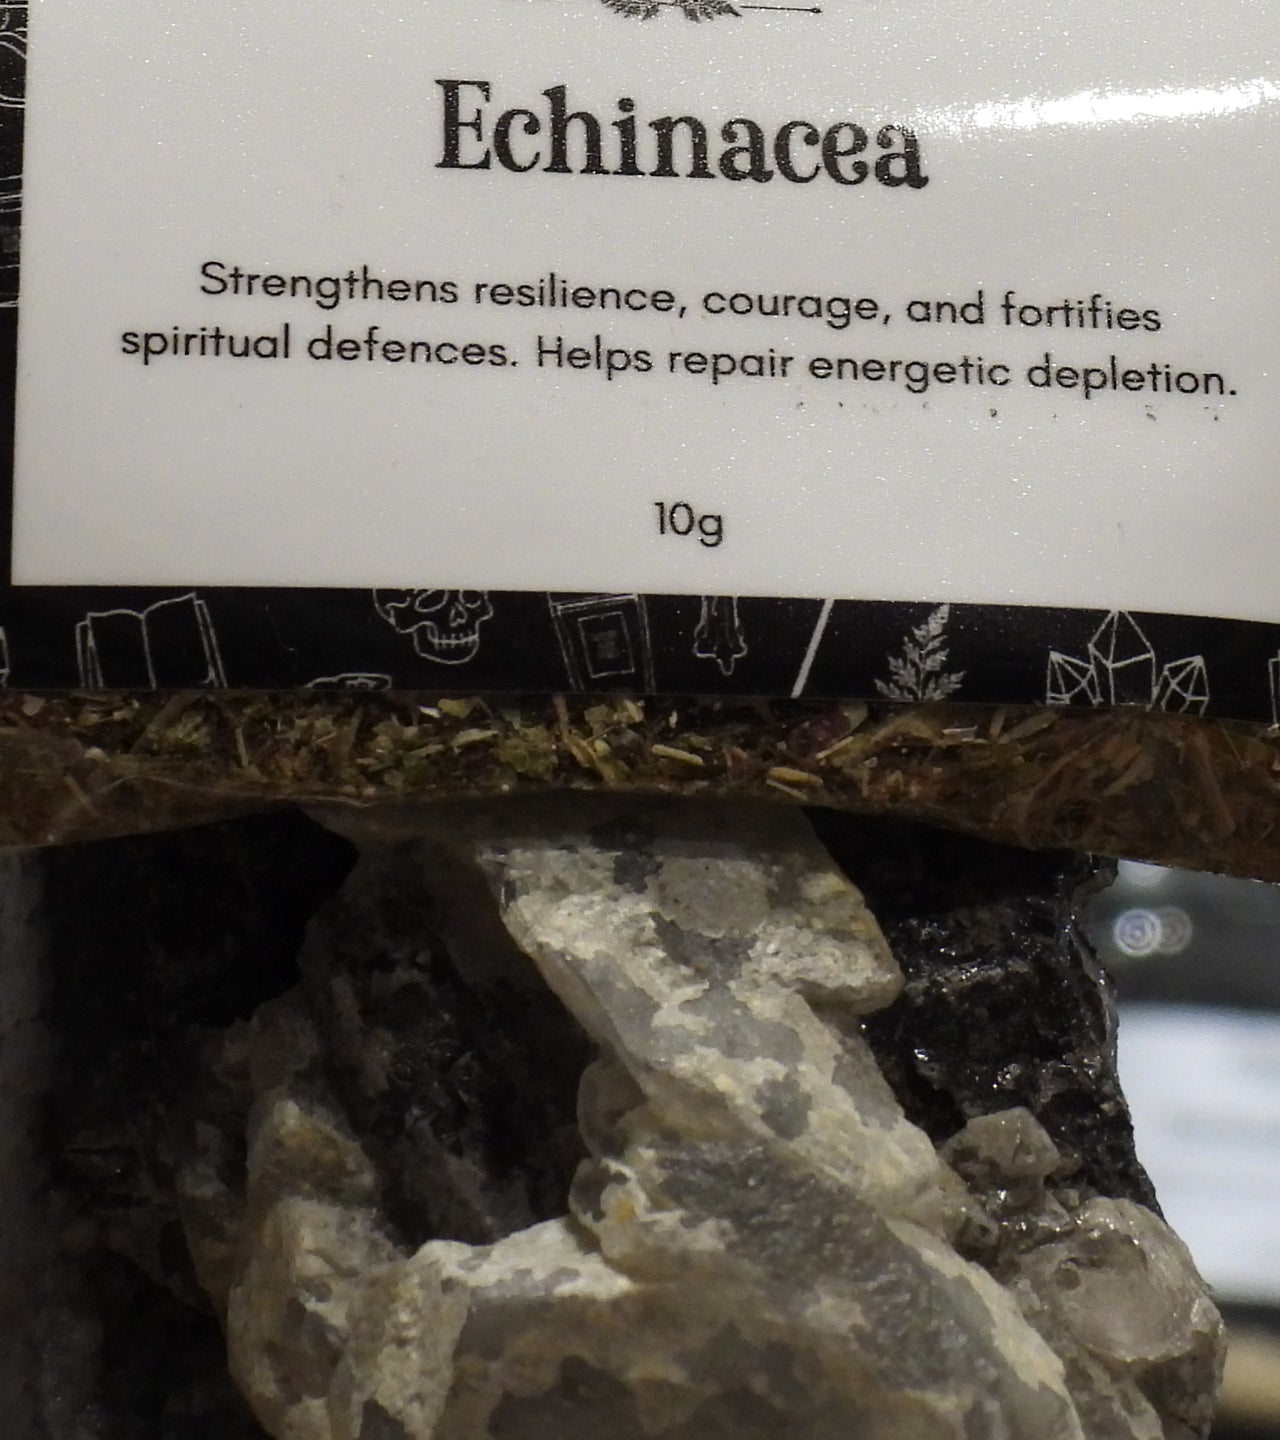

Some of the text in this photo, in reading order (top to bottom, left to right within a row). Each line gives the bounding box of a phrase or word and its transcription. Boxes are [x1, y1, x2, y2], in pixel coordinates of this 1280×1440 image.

[434, 79, 930, 190] Echinacea
[200, 261, 1161, 332] Strengthens resilience, courage, and fortifies
[121, 322, 1237, 400] spiritual defences. Helps repair energetic depletion.
[654, 501, 724, 548] 10g
